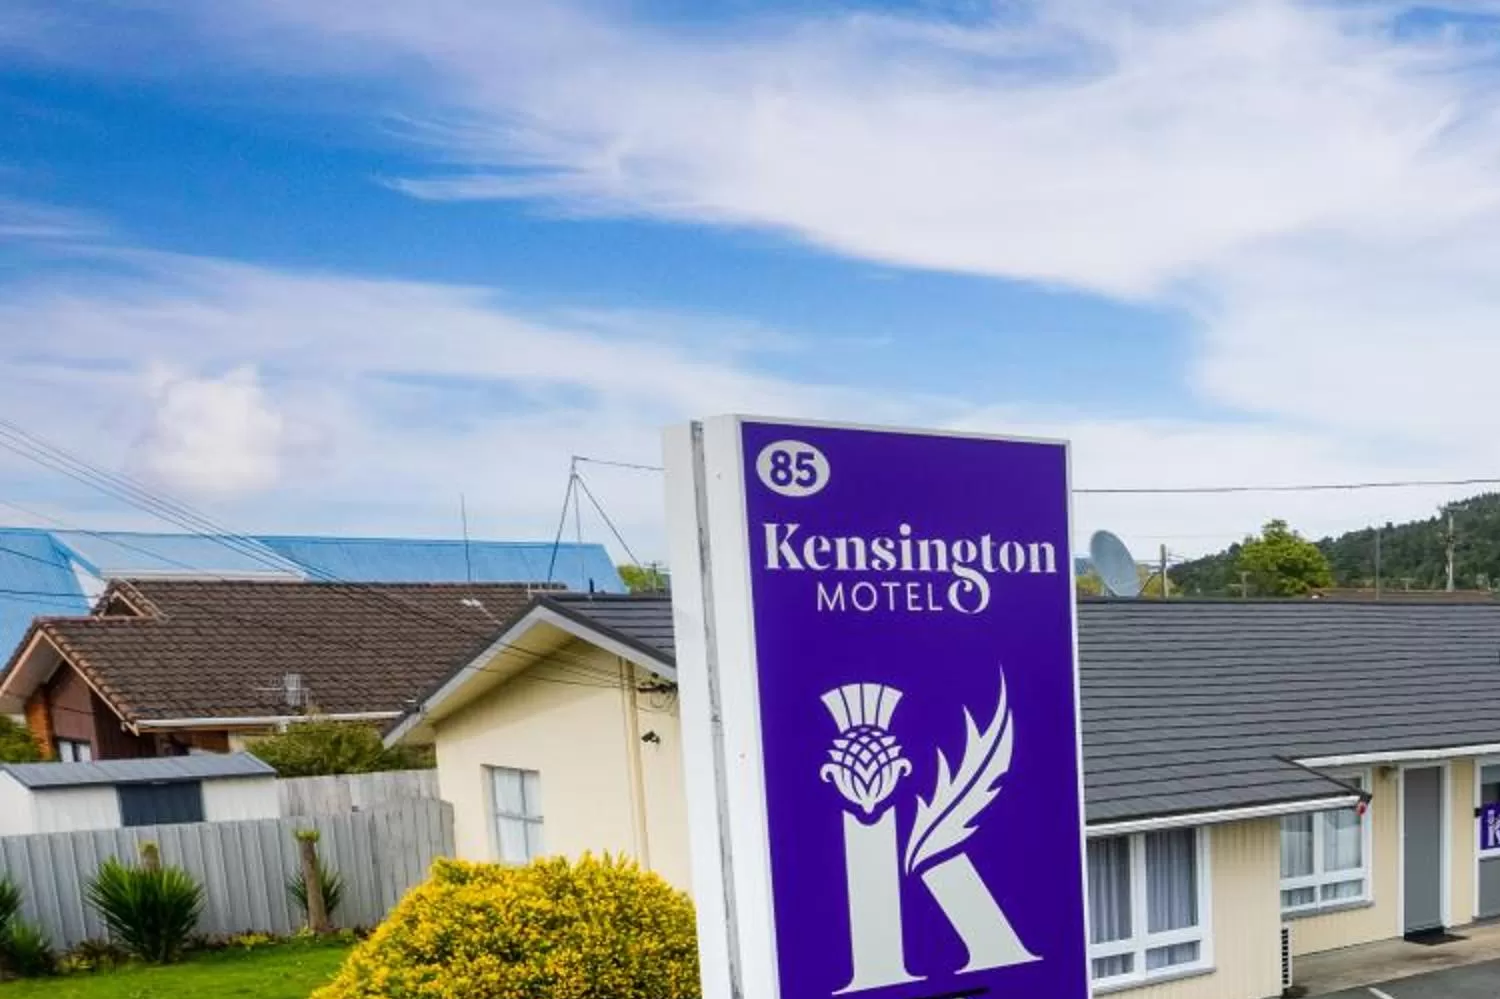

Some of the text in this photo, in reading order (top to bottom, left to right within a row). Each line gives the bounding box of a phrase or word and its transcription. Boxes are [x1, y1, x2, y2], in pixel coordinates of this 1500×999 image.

[769, 450, 818, 488] 85
[763, 523, 1057, 614] Kensington
[817, 581, 943, 612] MOTEL
